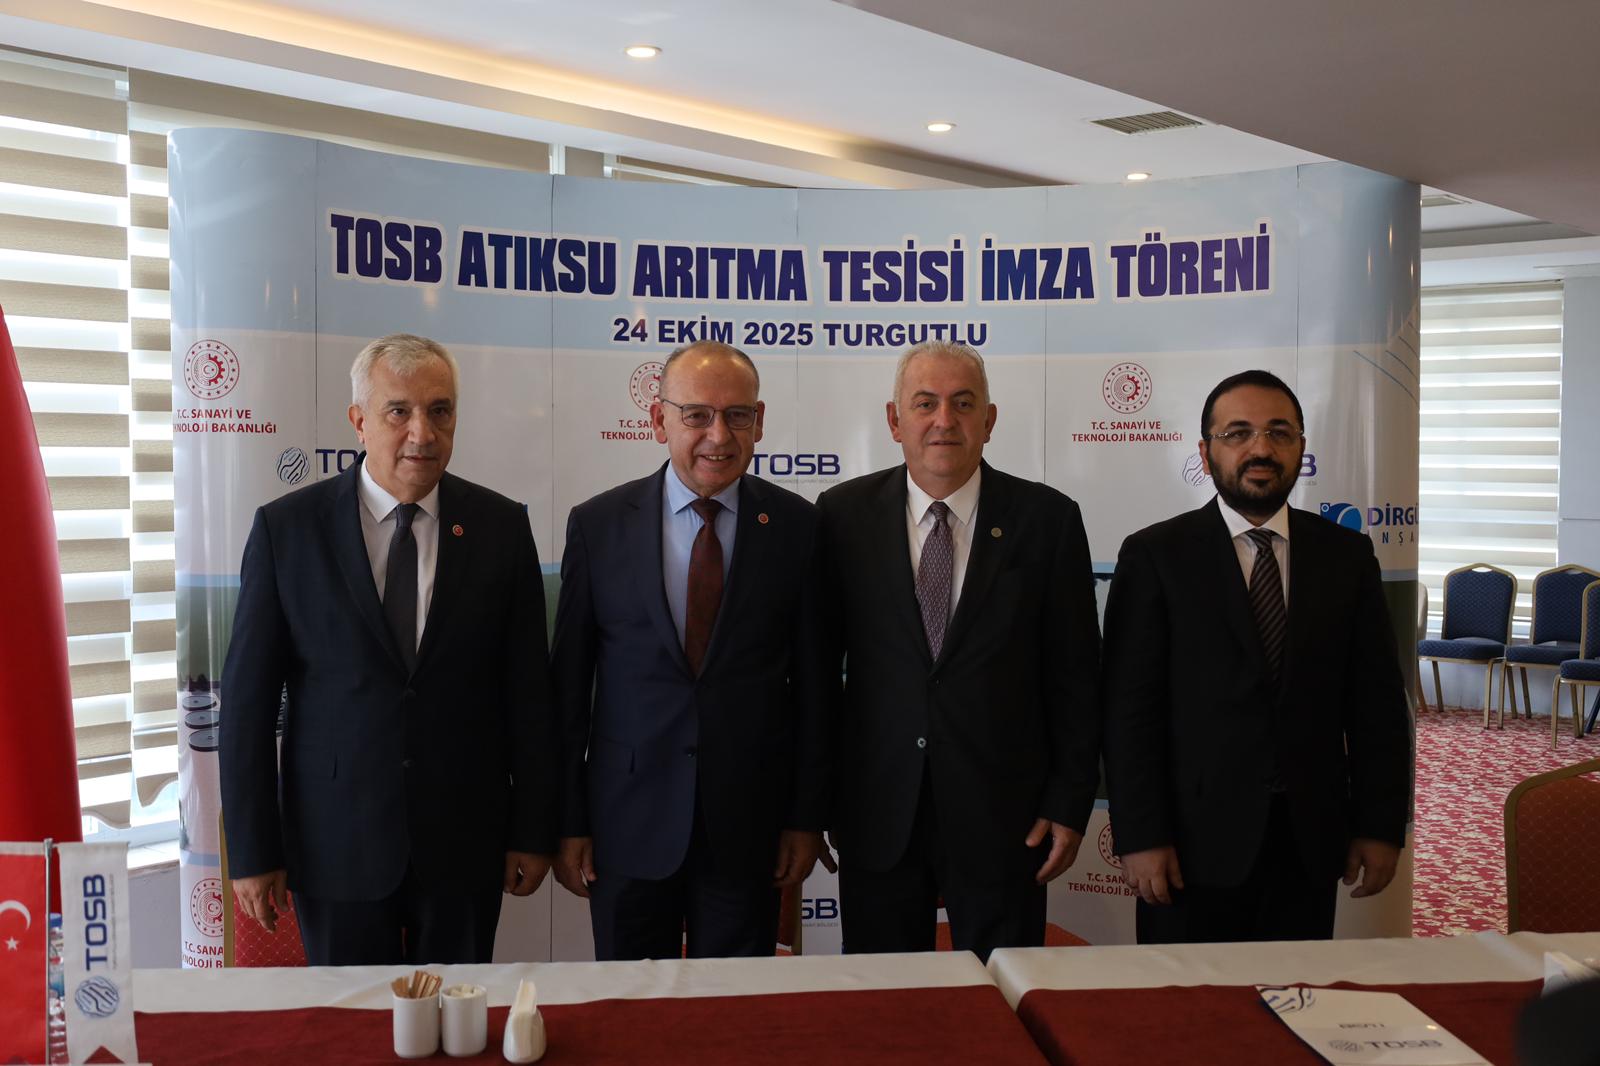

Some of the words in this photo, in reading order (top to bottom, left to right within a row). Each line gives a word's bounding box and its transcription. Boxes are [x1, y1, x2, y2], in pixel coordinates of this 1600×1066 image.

[330, 213, 443, 284] TOSB
[457, 230, 618, 296] ATIKSU
[632, 244, 809, 300] ARITMA
[822, 239, 965, 302] TESİSİ
[981, 238, 1095, 300] İMZA
[1110, 222, 1271, 298] TÖRENİ
[613, 318, 648, 342] 24
[658, 315, 733, 344] EKİM
[744, 322, 813, 345] 2025
[823, 323, 987, 346] TURGUTLU
[191, 407, 232, 419] SANAYİ
[236, 409, 251, 419] VE
[211, 421, 277, 434] BAKANLIĞI
[619, 419, 635, 429] T.C.
[1091, 421, 1108, 430] T.C.
[1110, 419, 1146, 430] SANAYİ
[1149, 421, 1161, 430] VE
[601, 430, 653, 441] TEKNOLOJİ
[1072, 431, 1126, 442] TEKNOLOJİ
[1128, 432, 1183, 442] BAKANLIĞI
[315, 449, 358, 473] TO
[753, 454, 841, 475] TOSB
[1086, 873, 1103, 882] T.C.
[1106, 874, 1125, 884] SAN
[1068, 882, 1121, 895] TEKNOLOJİ
[800, 899, 838, 919] SB
[83, 874, 108, 971] TOSB
[197, 945, 224, 956] SANA
